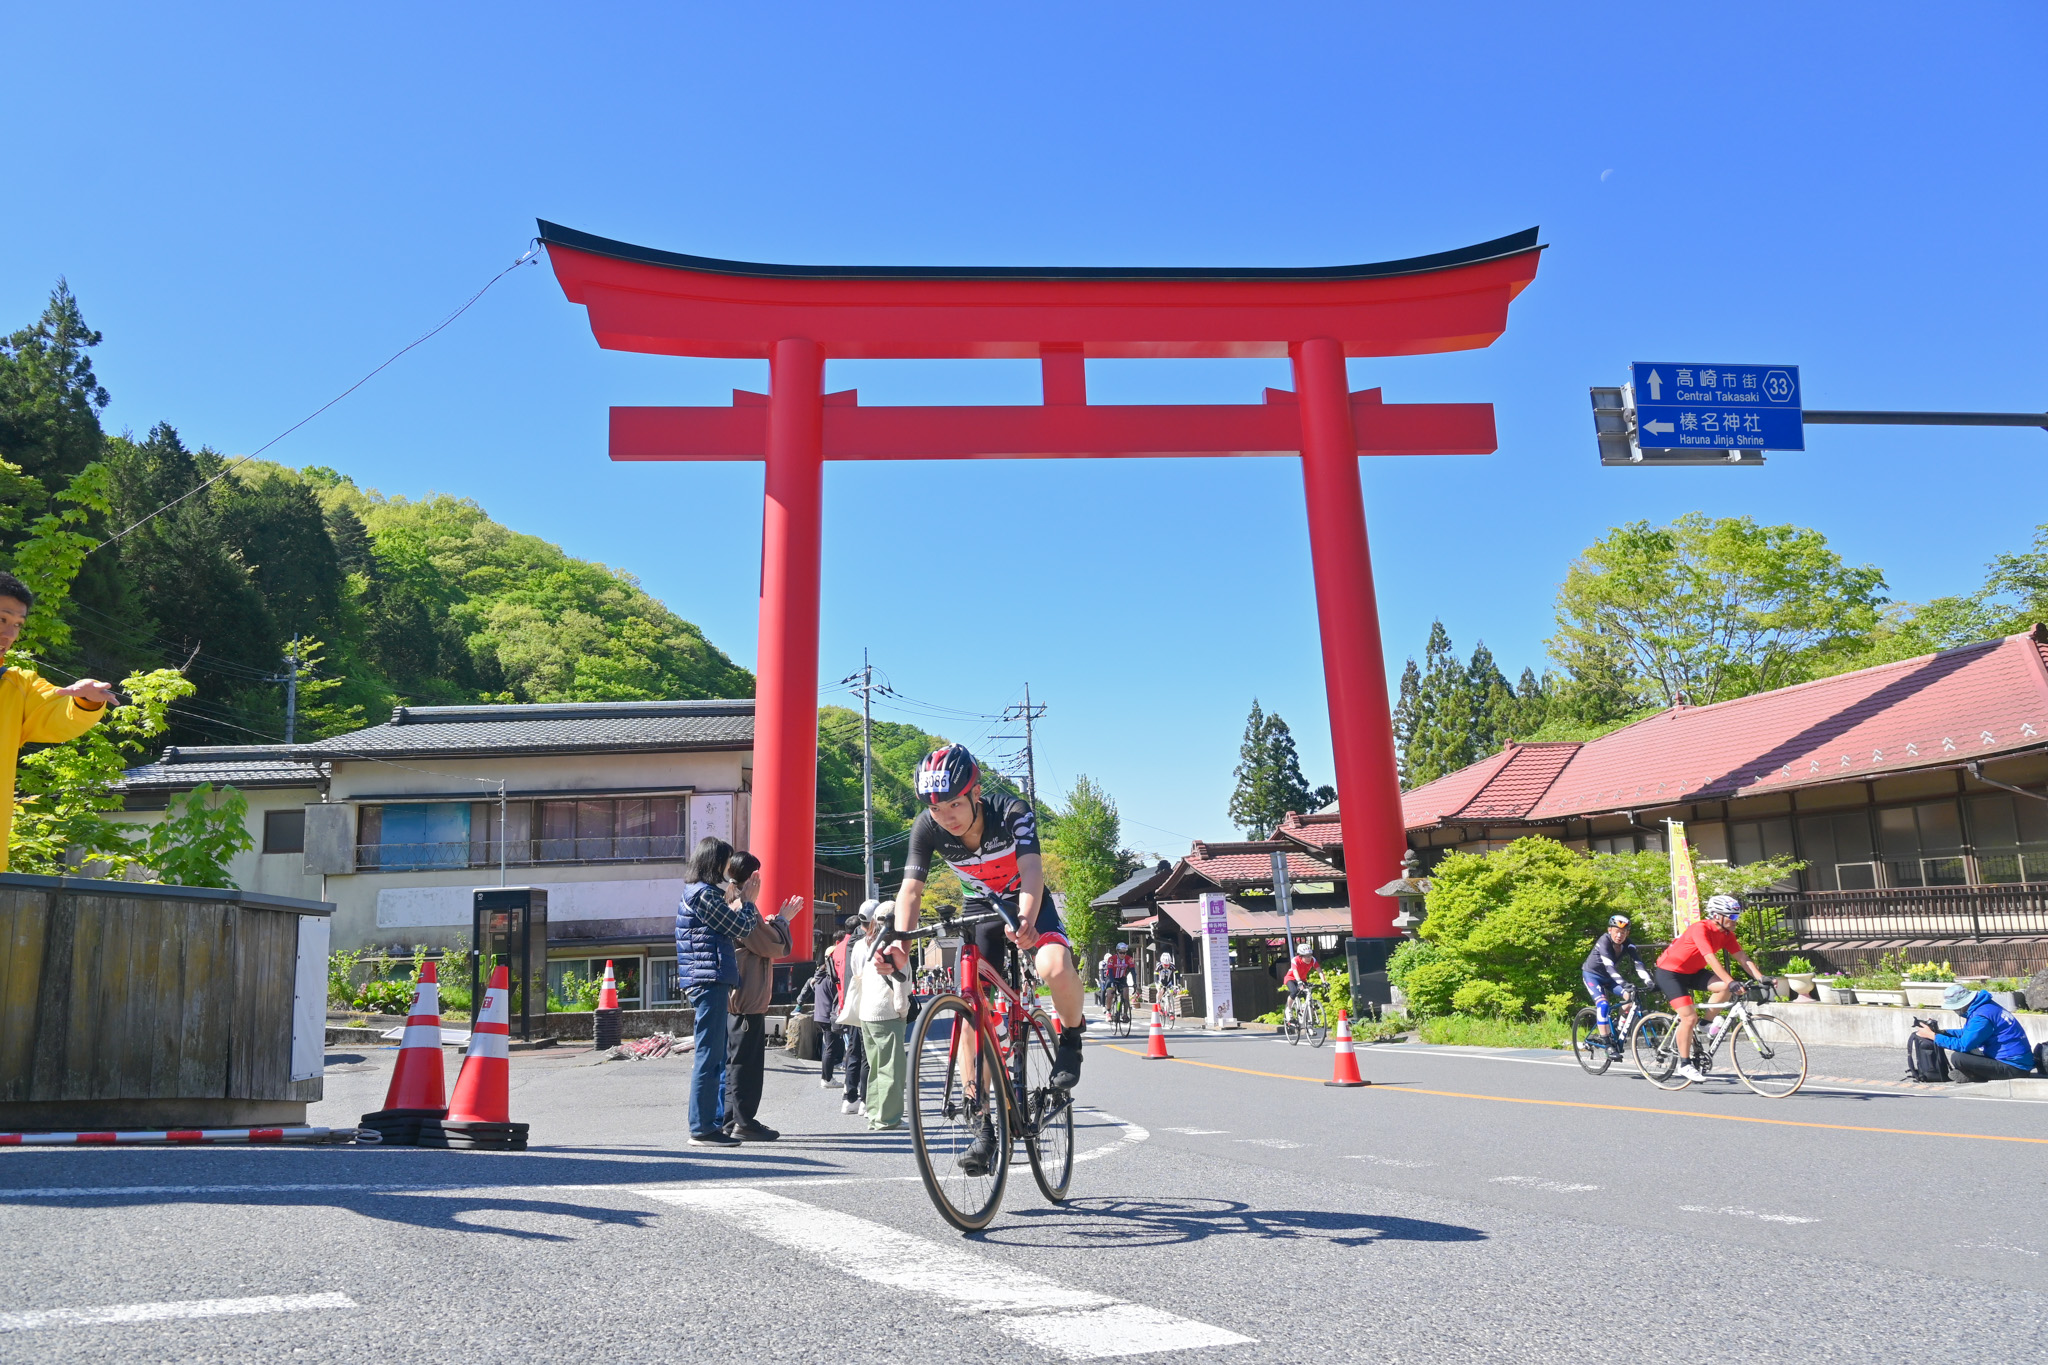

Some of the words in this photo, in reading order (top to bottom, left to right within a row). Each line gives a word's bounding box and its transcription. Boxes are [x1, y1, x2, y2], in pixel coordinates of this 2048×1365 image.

[1676, 368, 1757, 388] 高崎市街
[1769, 378, 1788, 395] 33
[1676, 389, 1712, 401] Central
[1715, 391, 1760, 402] Takasaki
[1679, 412, 1762, 432] 榛名神社
[1679, 434, 1711, 445] Haruna
[1713, 434, 1735, 447] Jinja
[1736, 434, 1764, 446] Shrine
